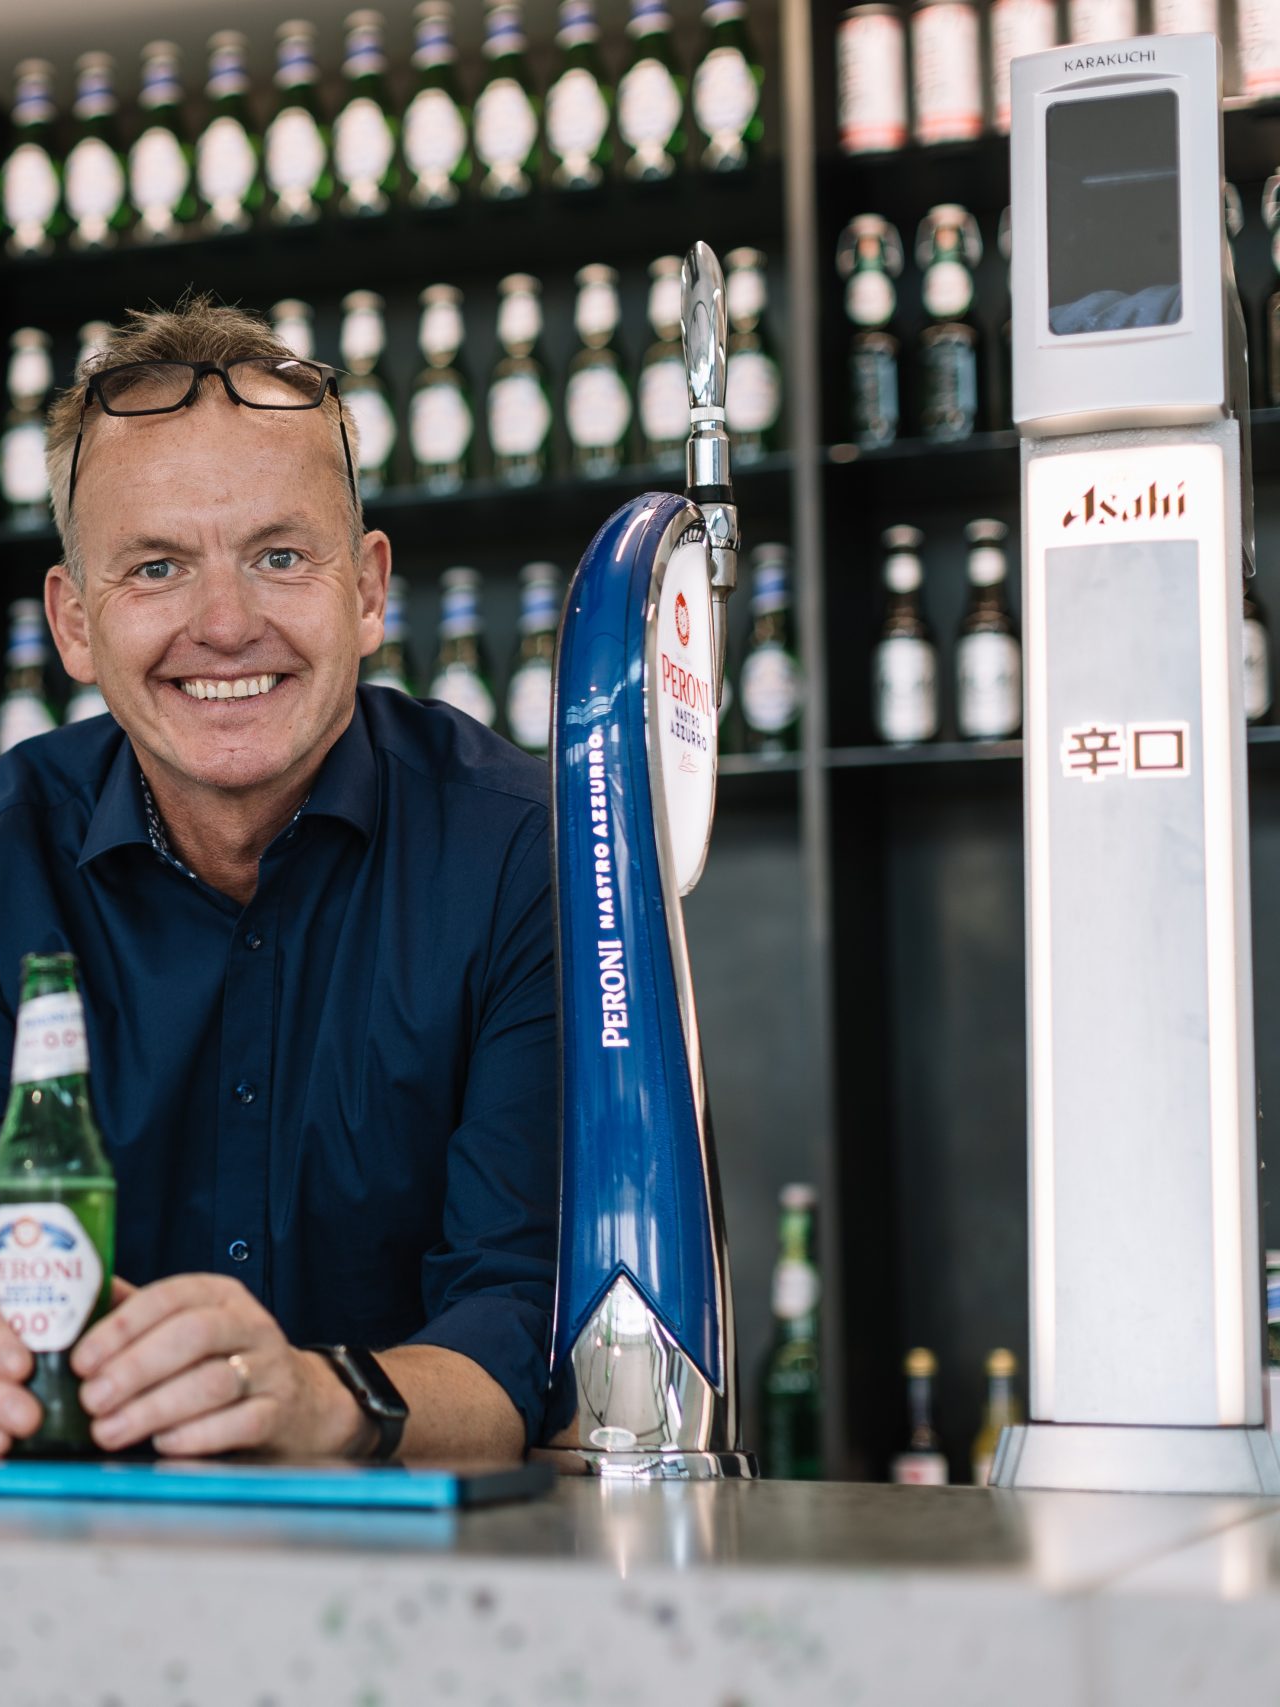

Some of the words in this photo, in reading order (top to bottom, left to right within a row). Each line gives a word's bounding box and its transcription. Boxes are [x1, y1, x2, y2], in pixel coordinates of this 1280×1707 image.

[1064, 50, 1156, 73] KARAKUCHI
[1062, 480, 1185, 528] Asahi
[661, 652, 711, 718] PERONI
[670, 719, 707, 751] AZZURRO
[674, 705, 700, 729] NASTRO
[1067, 726, 1184, 775] 辛口
[588, 733, 609, 837] AZZURRO
[594, 843, 615, 929] NASTRO
[598, 939, 630, 1049] PERONI
